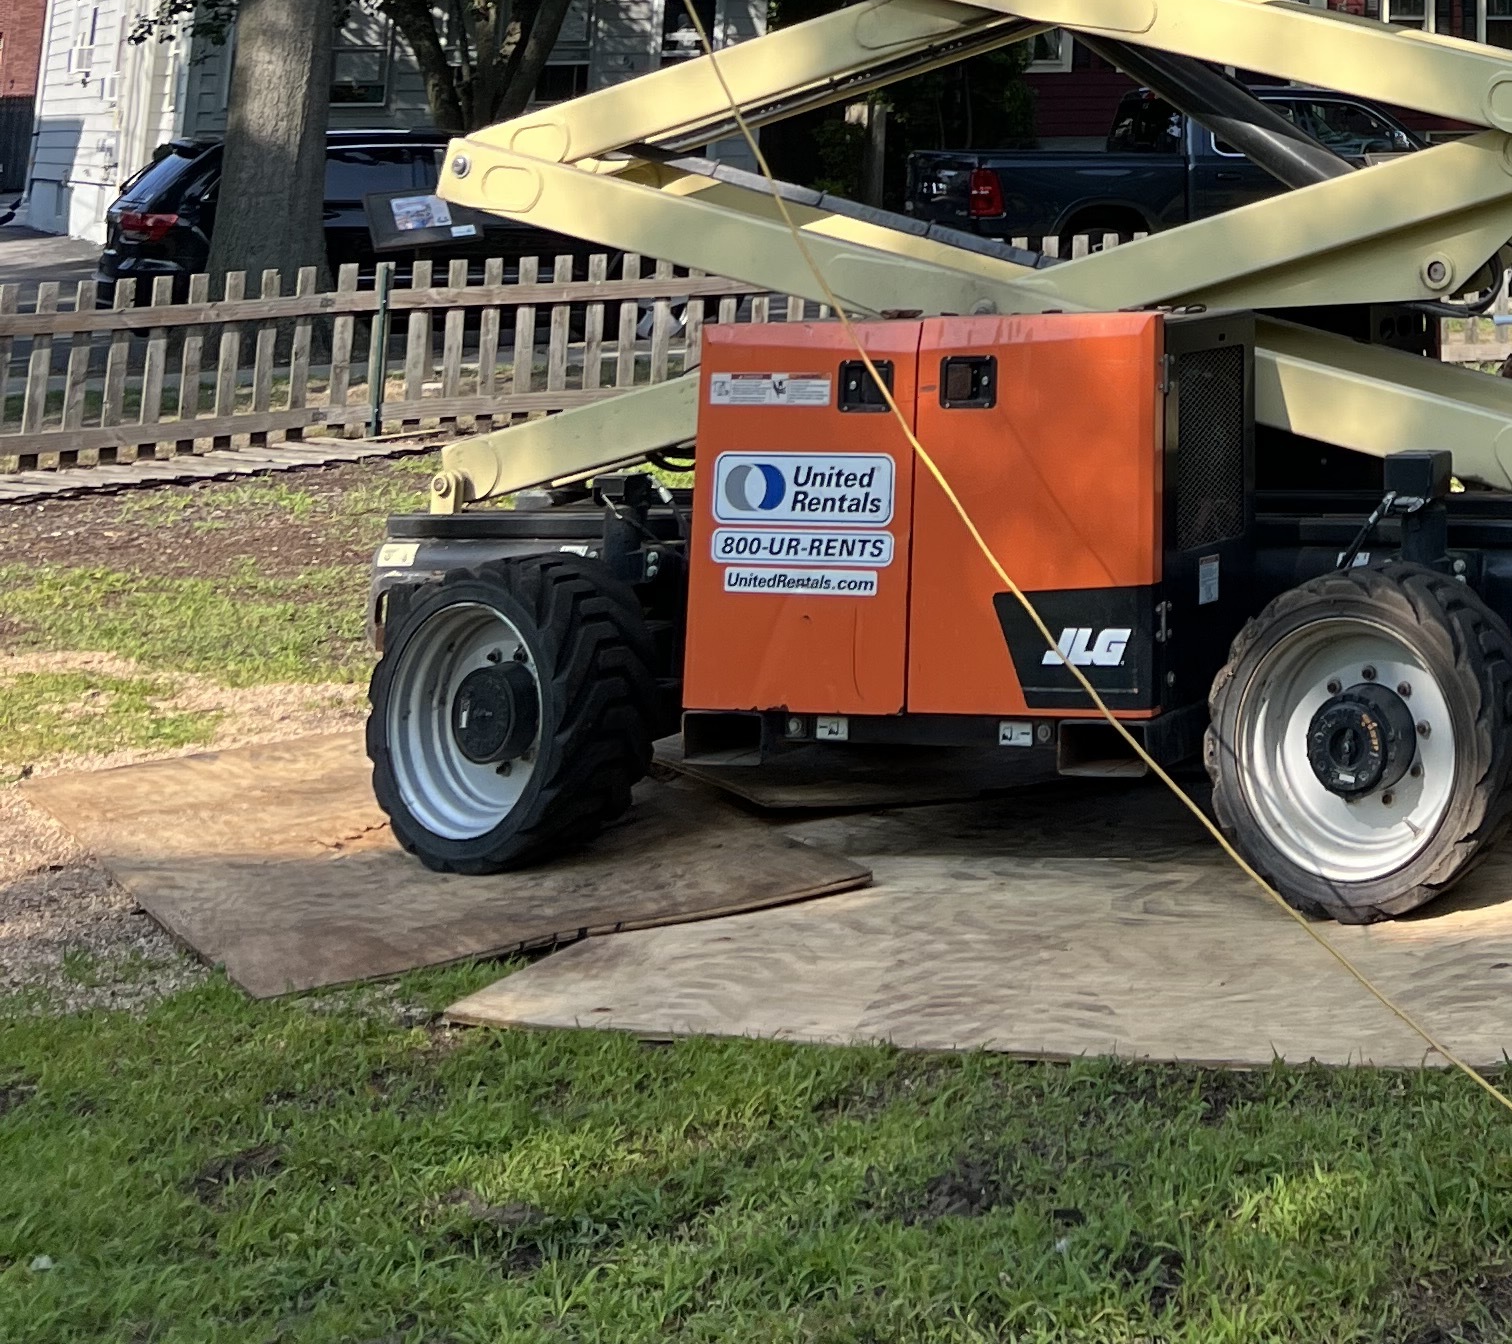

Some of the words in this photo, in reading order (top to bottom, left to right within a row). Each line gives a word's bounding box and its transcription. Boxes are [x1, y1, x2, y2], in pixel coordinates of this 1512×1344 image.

[793, 466, 876, 489] United
[790, 491, 882, 514] Rentals
[721, 536, 886, 558] 800-UR-RENTS
[727, 572, 875, 592] UnitedRentals.com
[1041, 627, 1132, 666] JLG
